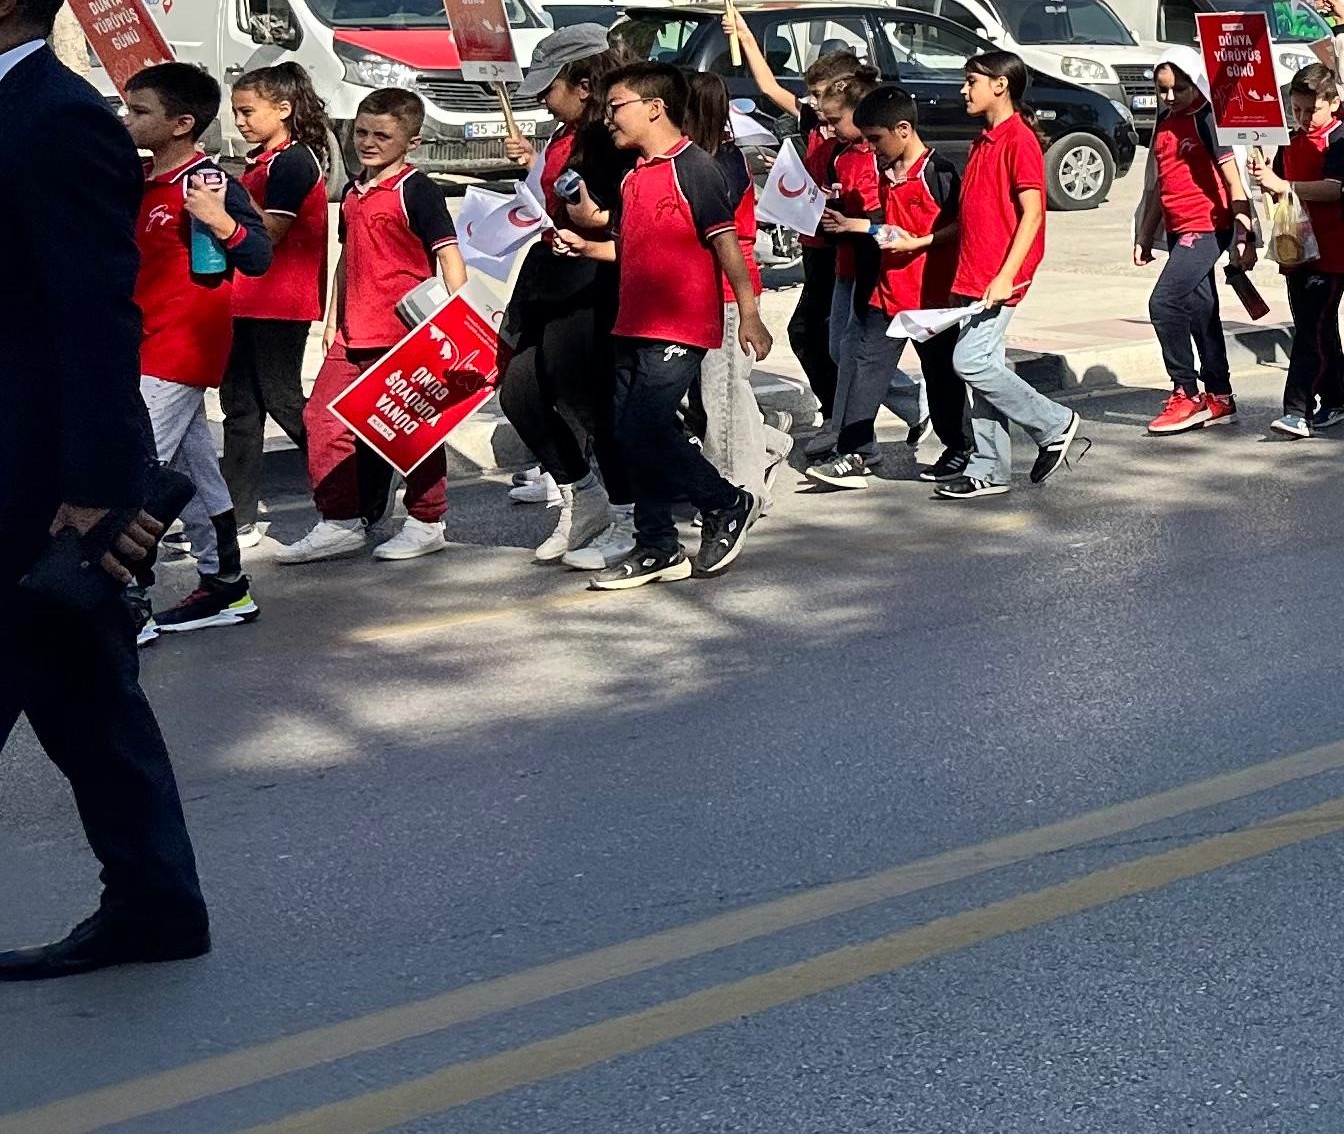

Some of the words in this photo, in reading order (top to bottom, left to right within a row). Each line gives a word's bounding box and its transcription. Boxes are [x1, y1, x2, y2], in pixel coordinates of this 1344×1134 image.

[93, 6, 140, 35] YÜRÜYÜŞ
[111, 27, 141, 50] GÜNÜ
[1218, 33, 1252, 47] DÜNYA
[1213, 49, 1261, 64] YÜRÜYÜŞ
[1226, 62, 1254, 77] GÜNÜ
[473, 123, 487, 135] 35
[409, 366, 450, 401] GÜNÜ
[384, 368, 443, 428] YÜRÜYÜŞ
[375, 392, 420, 436] DÜNYA
